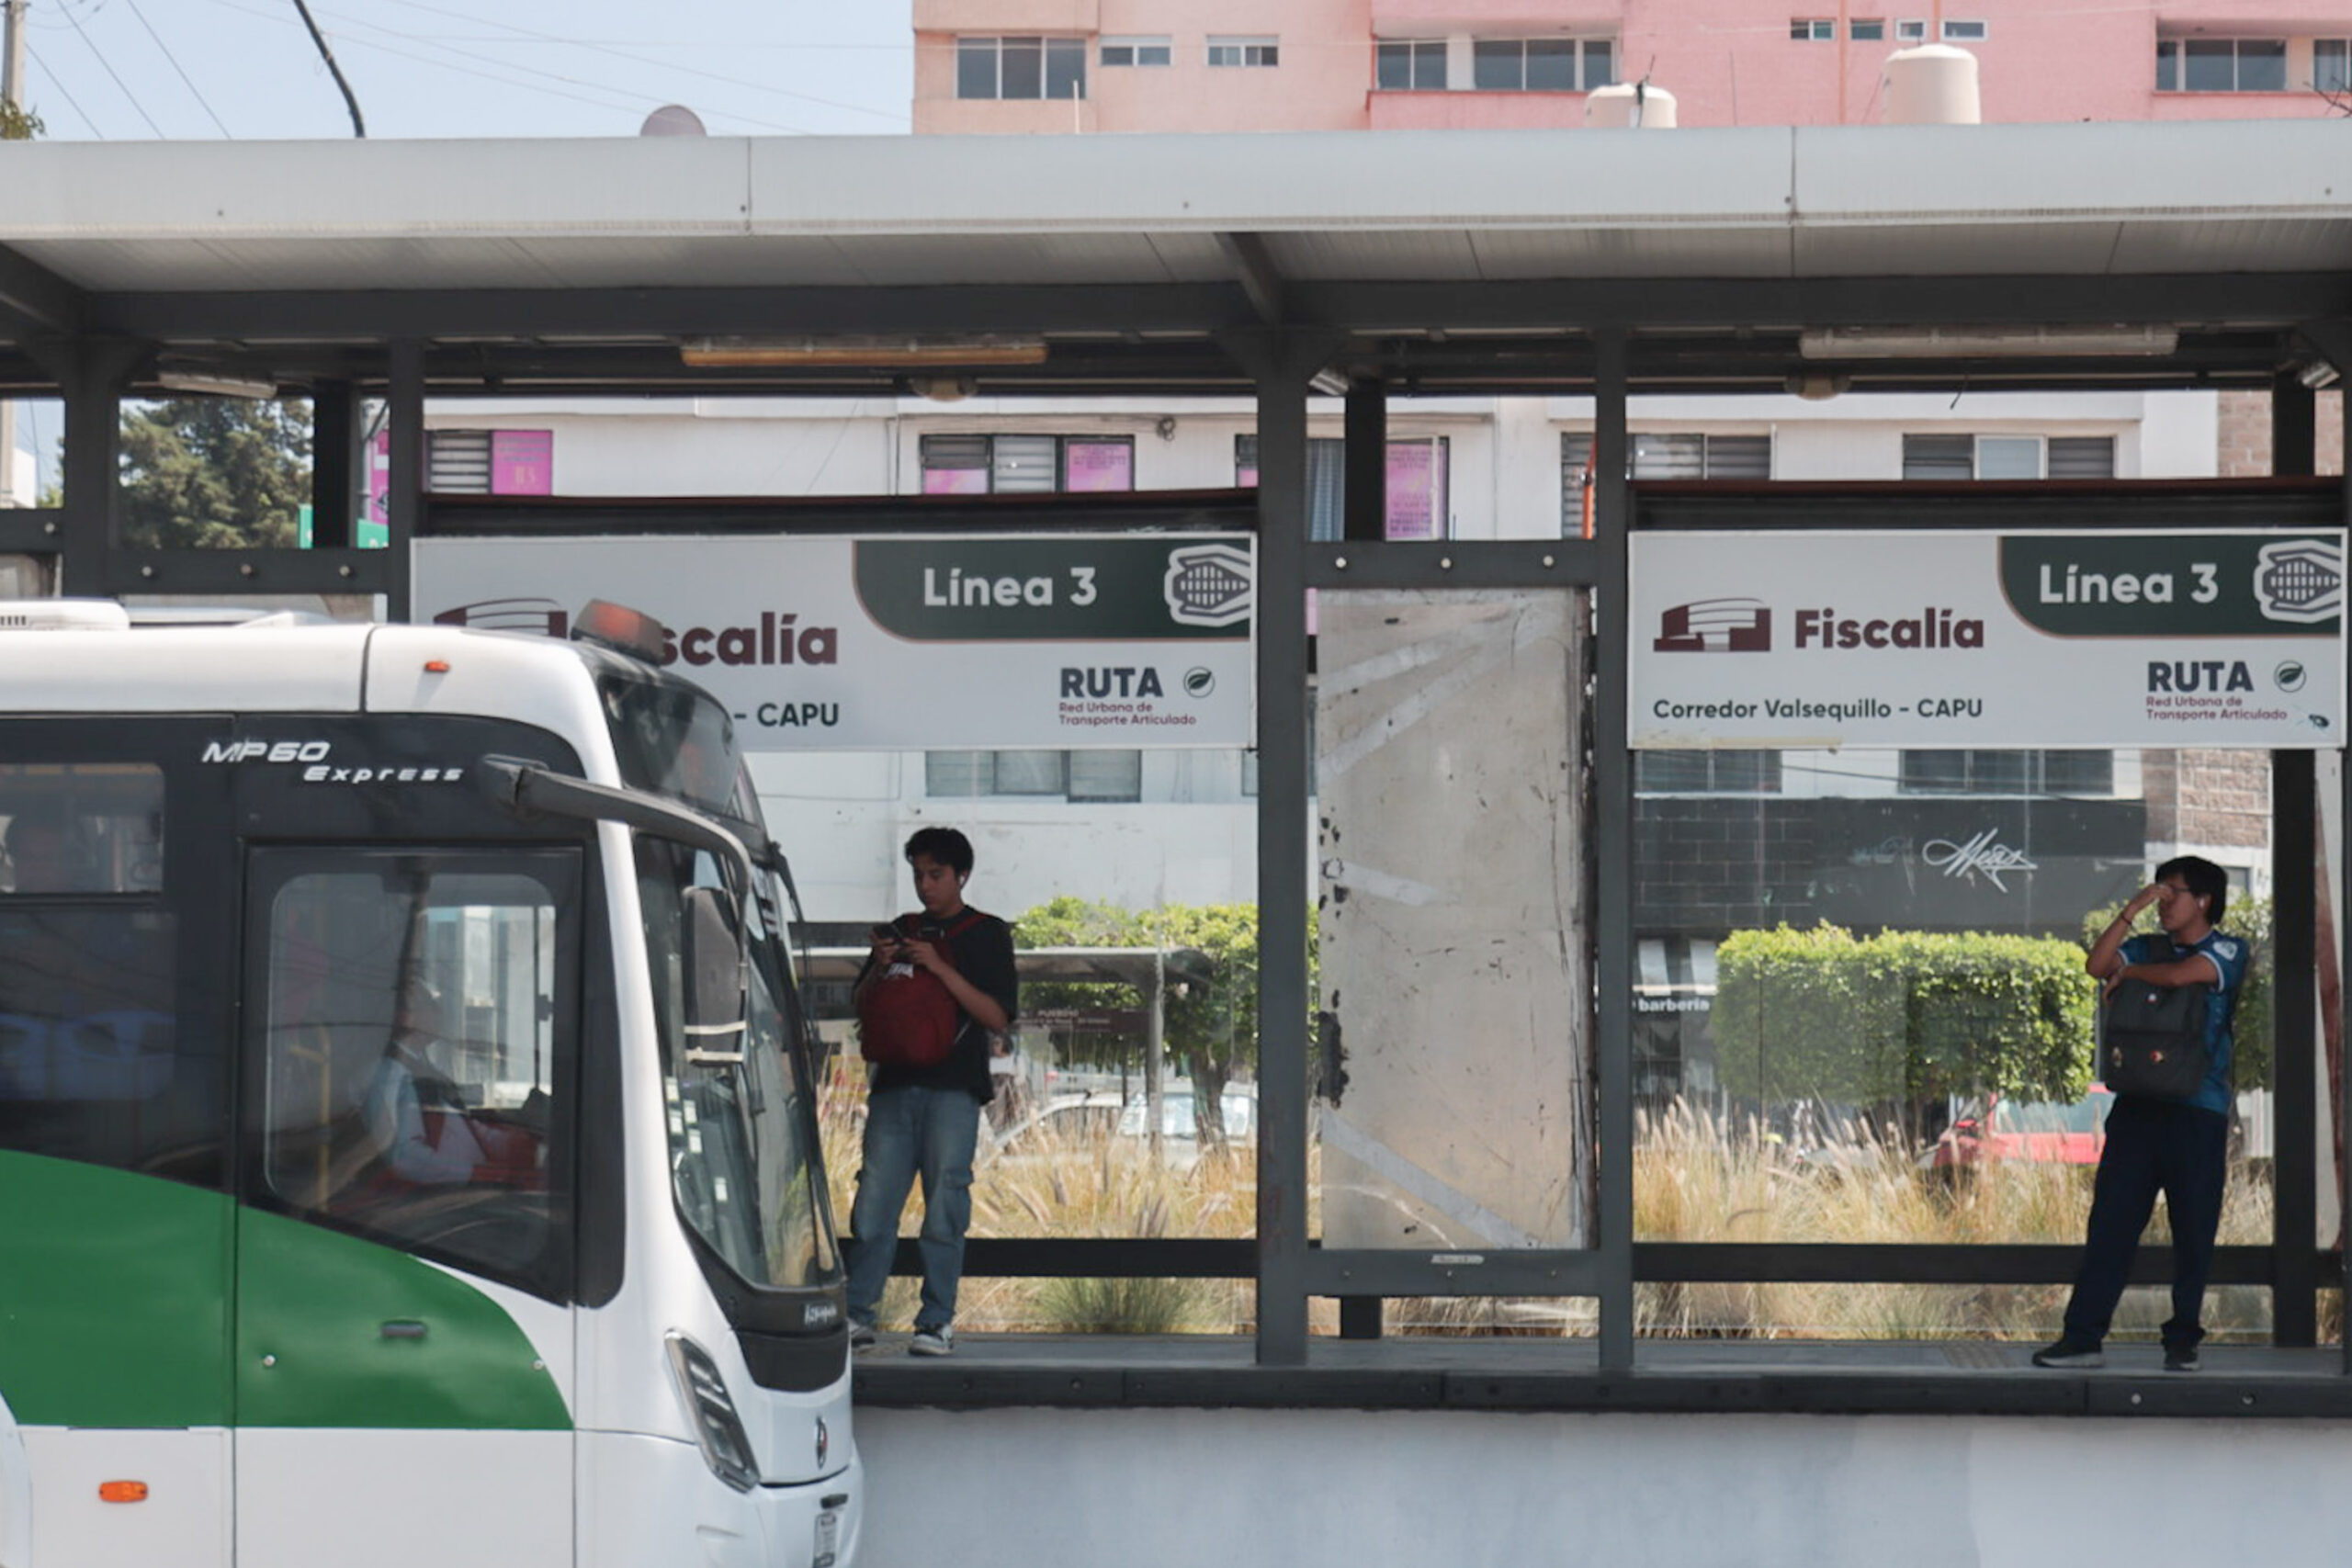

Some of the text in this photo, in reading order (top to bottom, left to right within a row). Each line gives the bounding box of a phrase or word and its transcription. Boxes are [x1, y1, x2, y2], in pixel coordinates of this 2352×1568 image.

[924, 567, 1097, 606] Línea 3
[2039, 563, 2220, 604] Línea 3
[660, 611, 838, 667] scalía
[1794, 607, 1984, 649] Fiscalía
[1060, 667, 1164, 698] RUTA
[2147, 661, 2255, 693] RUTA
[1058, 702, 1153, 713] Red Urbana de
[1653, 699, 1758, 718] Corredor
[1764, 699, 1892, 722] Valsequillo
[1917, 699, 1983, 718] CAPU
[2146, 696, 2243, 706] Red Urbana de
[757, 703, 839, 727] CAPU
[1059, 714, 1197, 727] Transporte Articulado
[2147, 708, 2288, 721] Transporte Articulado
[201, 740, 332, 763] MP60
[303, 765, 463, 784] Express
